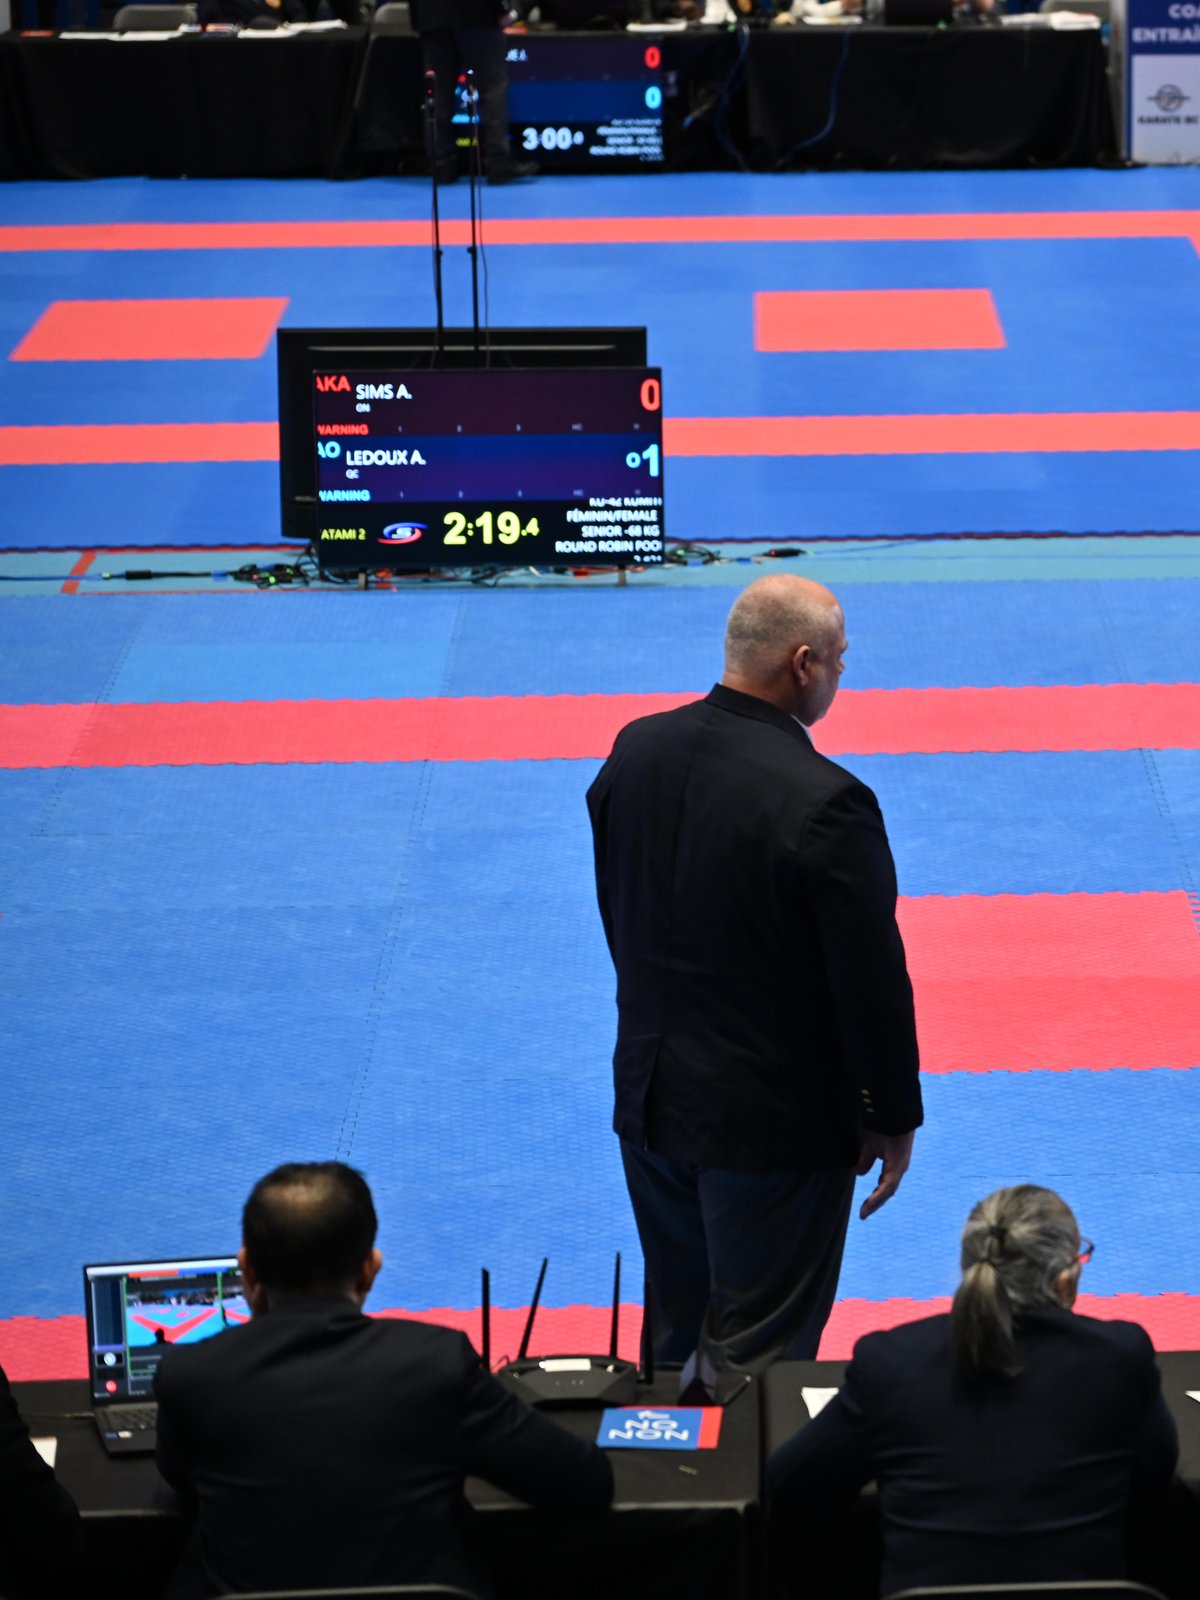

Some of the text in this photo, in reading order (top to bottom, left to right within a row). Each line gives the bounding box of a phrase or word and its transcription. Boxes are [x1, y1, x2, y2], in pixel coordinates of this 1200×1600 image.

[645, 46, 661, 69] 0
[645, 86, 662, 109] 0
[355, 383, 413, 400] SIMS A.
[640, 378, 661, 412] 0
[346, 449, 427, 466] LEDOUX A.
[358, 528, 367, 541] 2
[443, 511, 540, 545] 2:19.4
[581, 525, 622, 538] SENIOR
[643, 525, 660, 537] KG
[555, 540, 597, 553] ROUND
[598, 540, 634, 553] ROBIN
[625, 1420, 678, 1430] NO
[608, 1429, 689, 1441] NON
